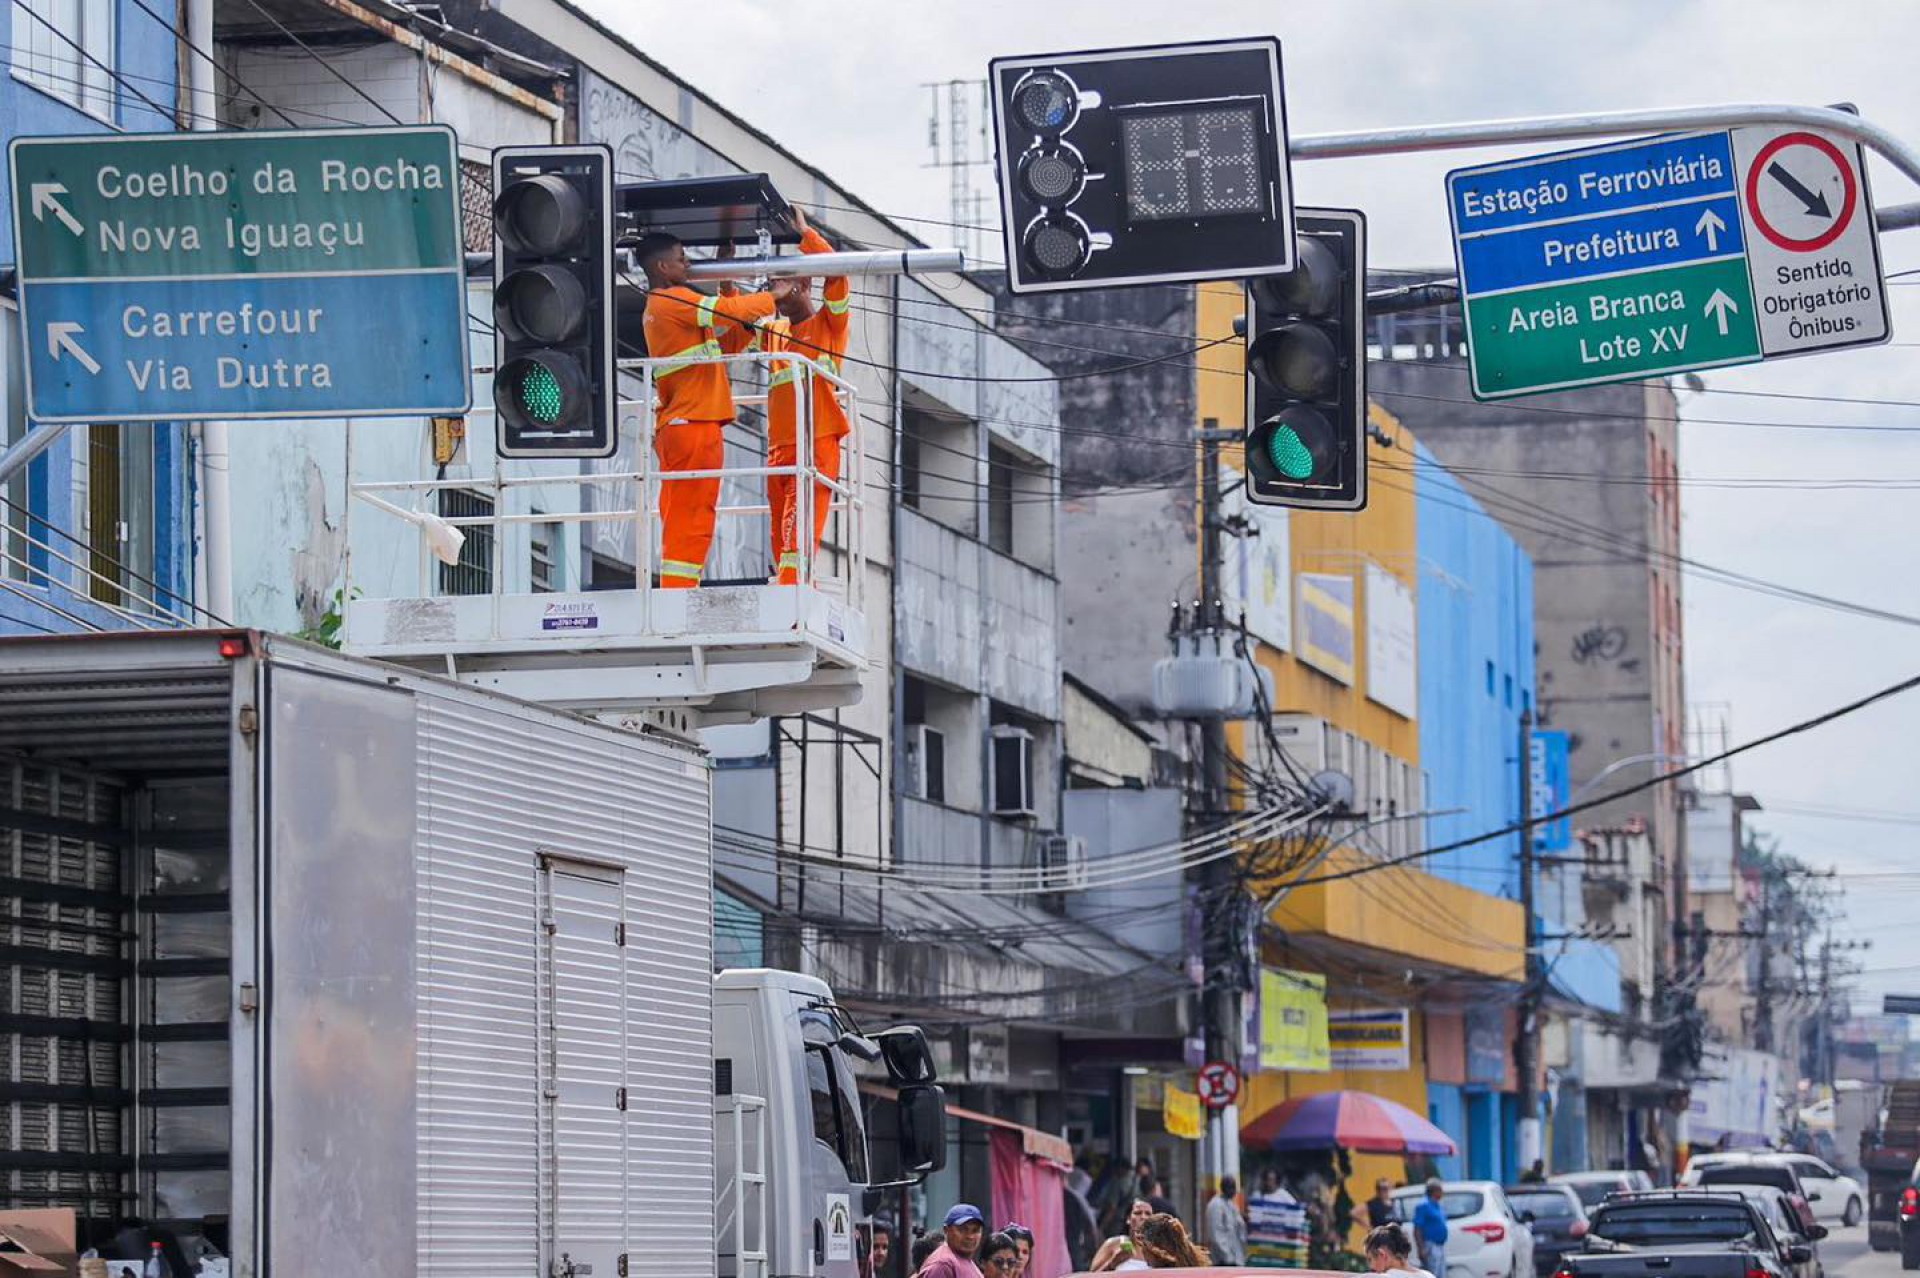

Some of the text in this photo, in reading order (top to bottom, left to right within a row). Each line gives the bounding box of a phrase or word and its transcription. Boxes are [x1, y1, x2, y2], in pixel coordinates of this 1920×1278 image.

[97, 158, 443, 199] Coelho da Rocha
[1463, 155, 1724, 218] Estação Ferroviária
[99, 218, 364, 256] Nova Iguaçu
[1544, 225, 1680, 267] Prefeitura
[1777, 257, 1852, 285] Sentido
[1508, 288, 1686, 333] Areia Branca
[1763, 284, 1871, 315] Obrigatório
[123, 303, 323, 338] Carrefour
[1788, 315, 1855, 340] Ônibus
[1580, 325, 1690, 364] Lote XV
[127, 357, 332, 391] Via Dutra
